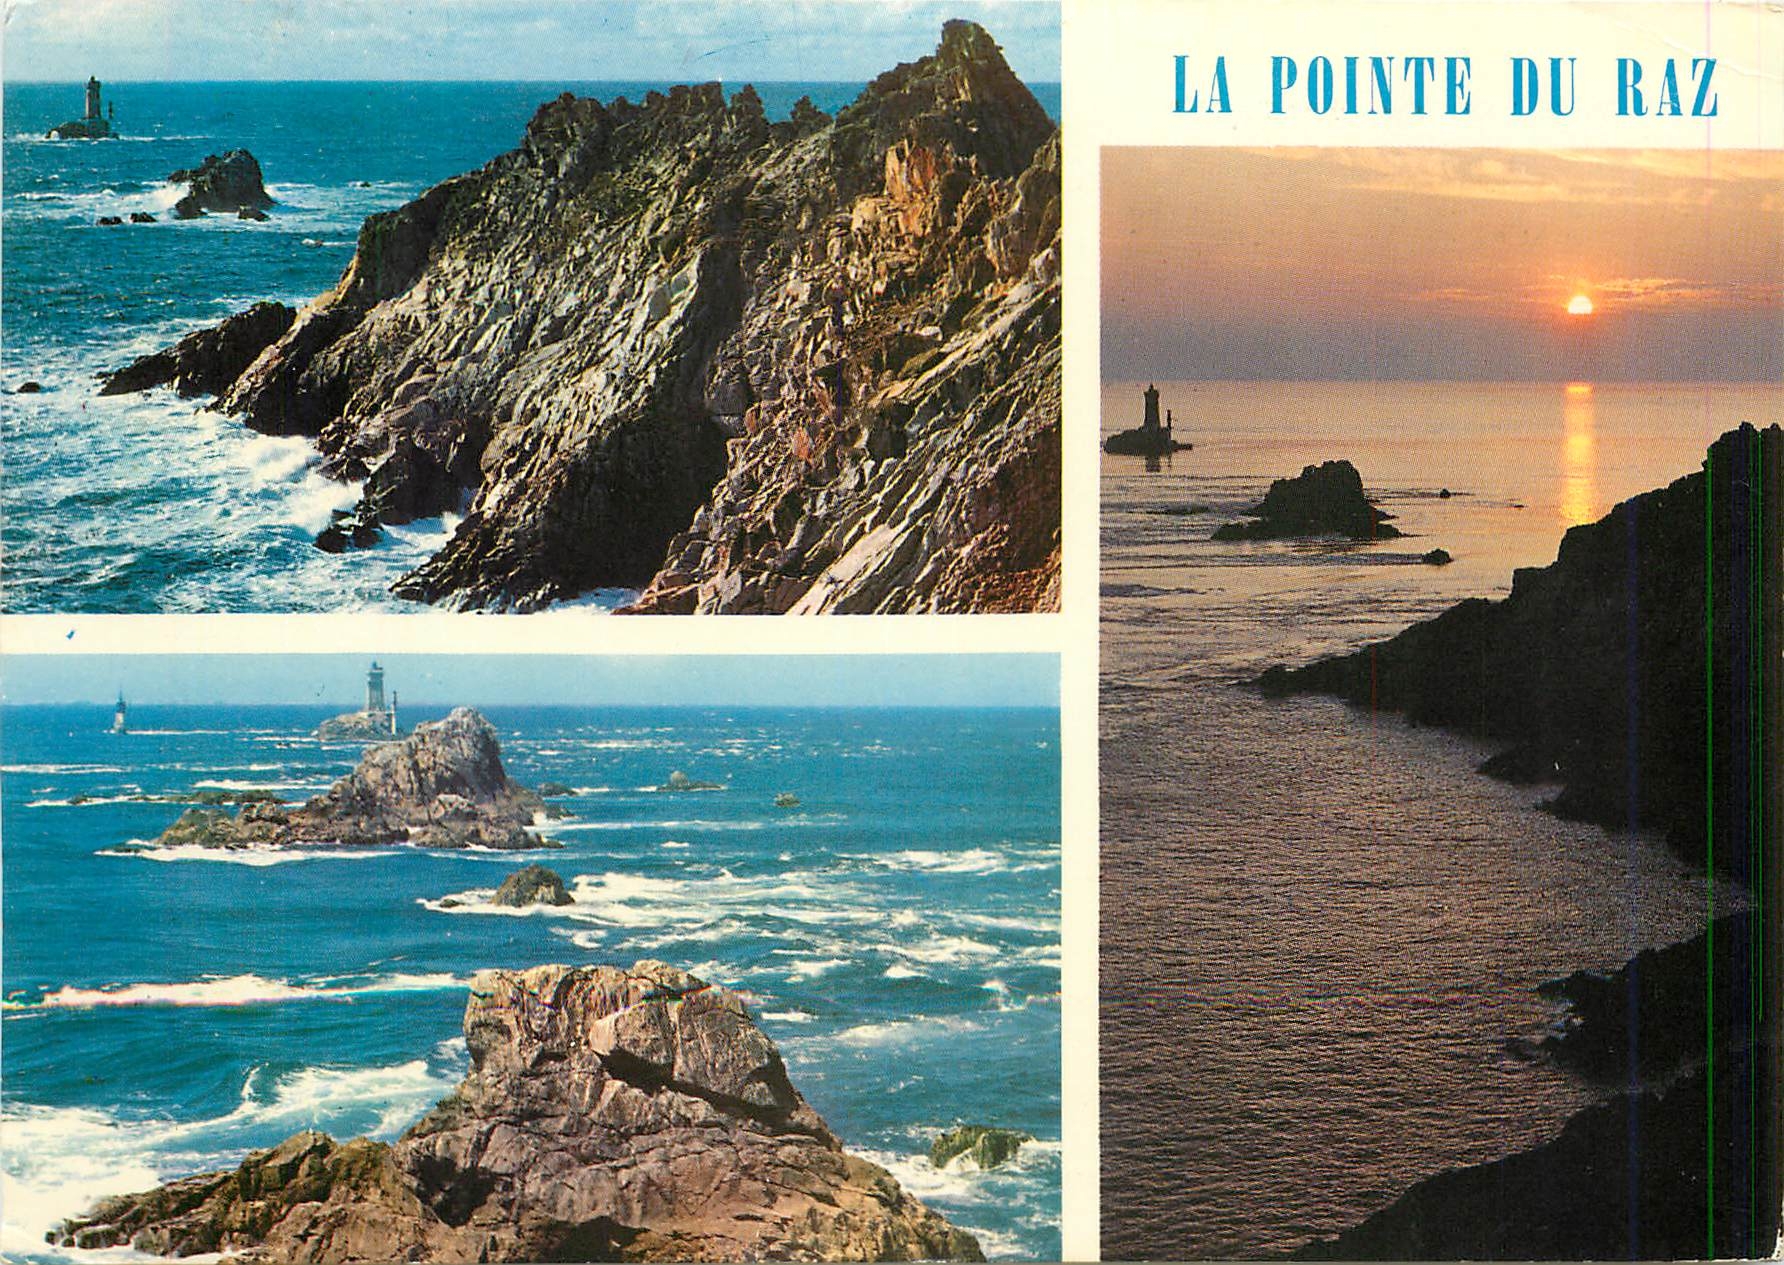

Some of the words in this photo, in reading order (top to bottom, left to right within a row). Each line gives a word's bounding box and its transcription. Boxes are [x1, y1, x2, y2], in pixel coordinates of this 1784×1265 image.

[1173, 55, 1232, 114] LA
[1270, 56, 1471, 115] POINTE
[1510, 57, 1577, 117] DU
[1615, 57, 1718, 117] RAZ
